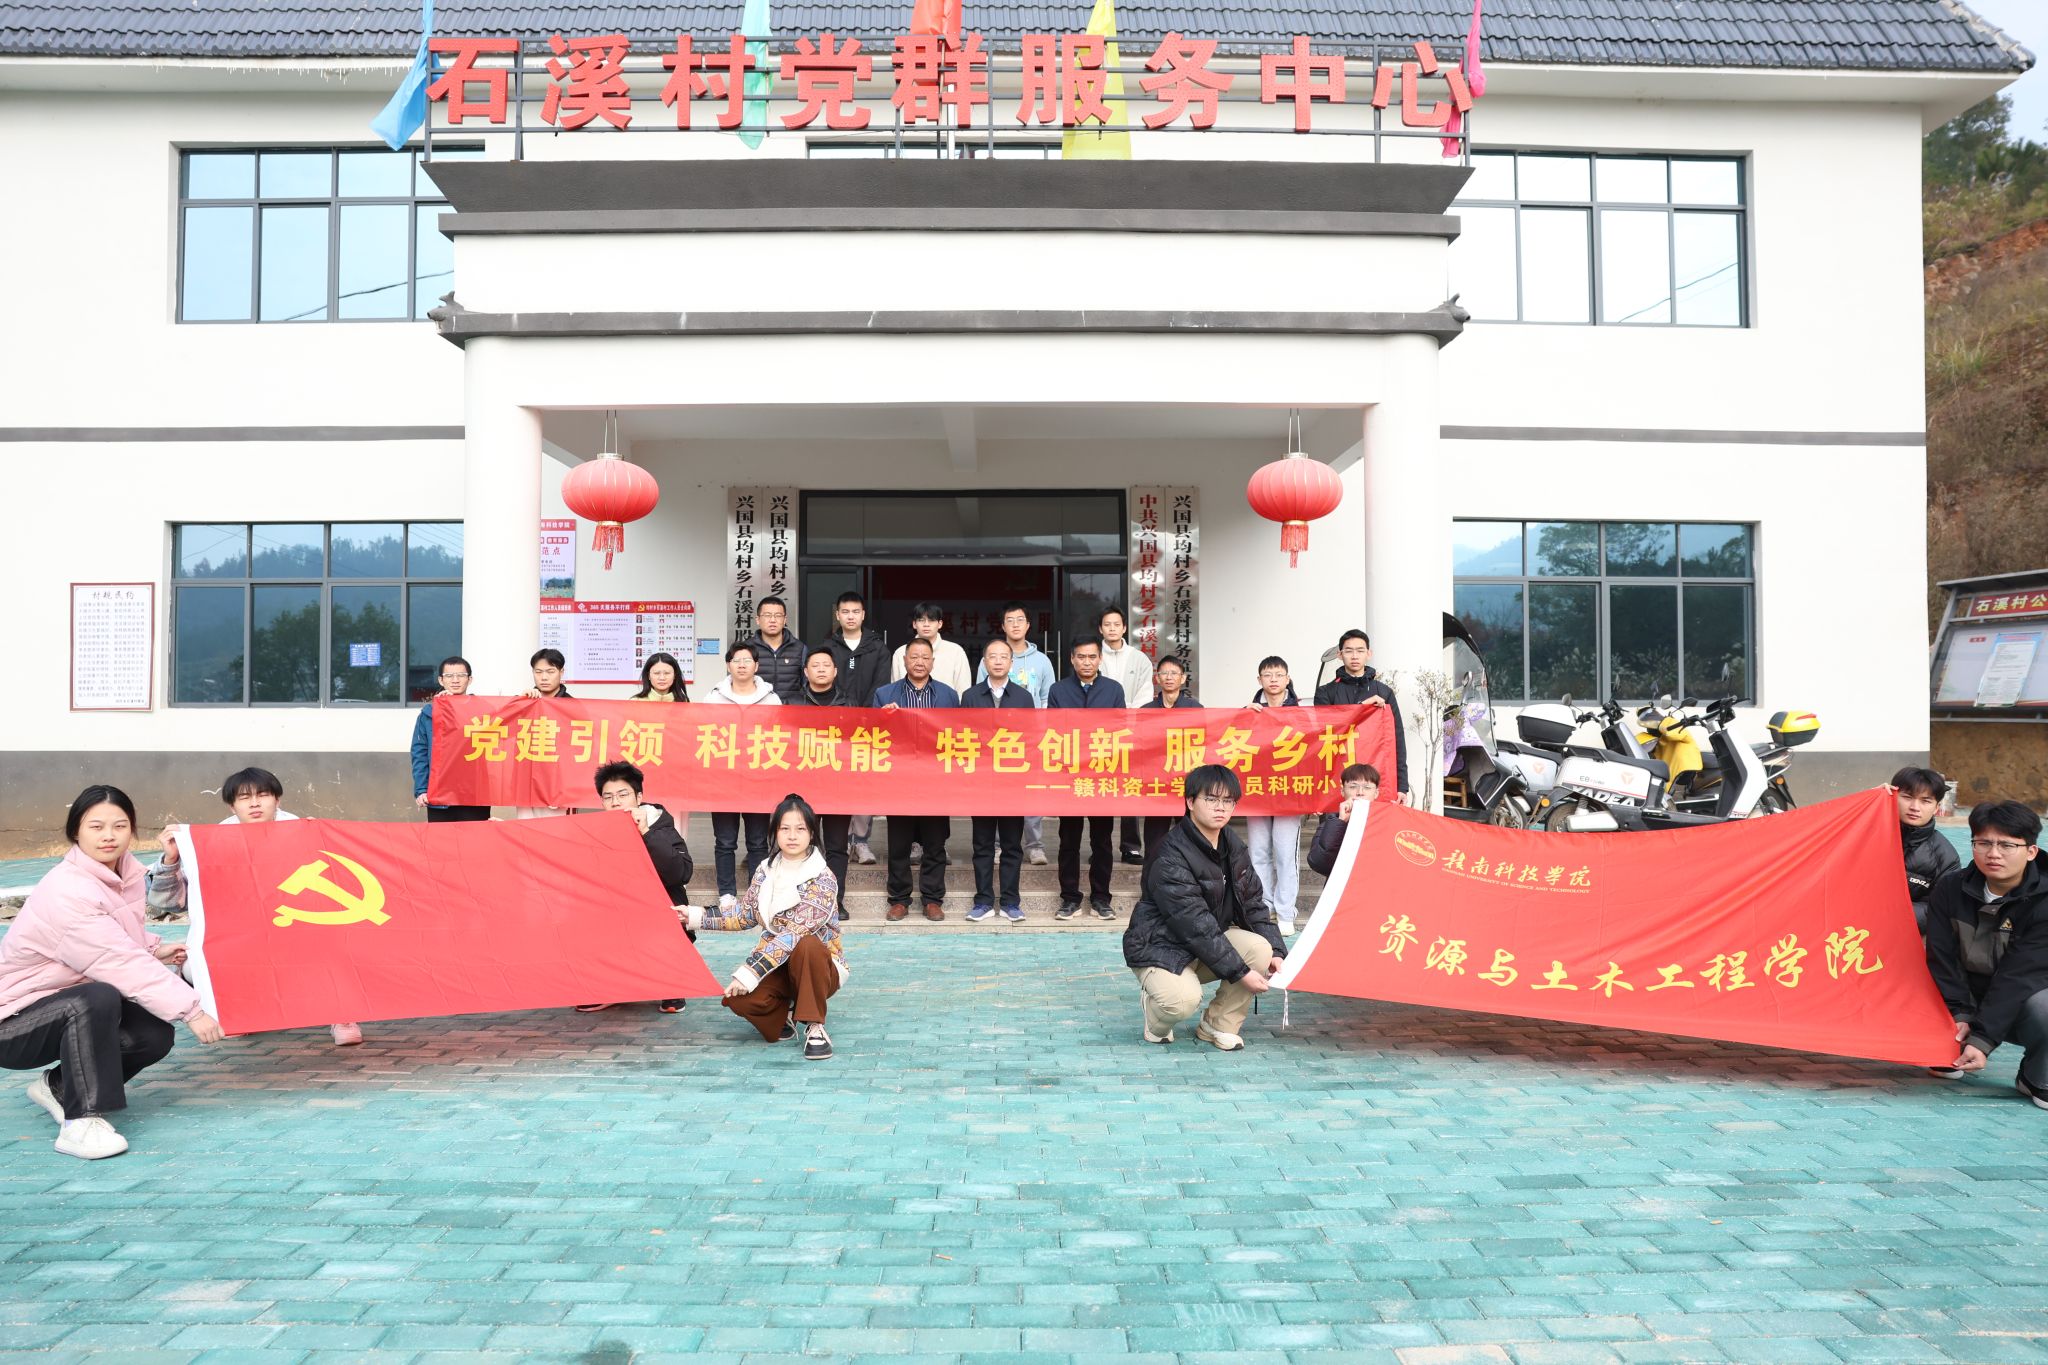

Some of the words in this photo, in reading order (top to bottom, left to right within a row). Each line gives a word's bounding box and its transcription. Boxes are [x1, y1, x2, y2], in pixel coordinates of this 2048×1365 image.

[426, 32, 1473, 132] 石溪村党群服务中心
[463, 715, 665, 767] 党建引领
[695, 722, 893, 773] 科技赋能
[935, 727, 1134, 775] 特色创新
[1163, 723, 1360, 774] 服务乡村
[1572, 785, 1636, 807] YADEA
[1378, 914, 1884, 999] 资源与土木工程学院
